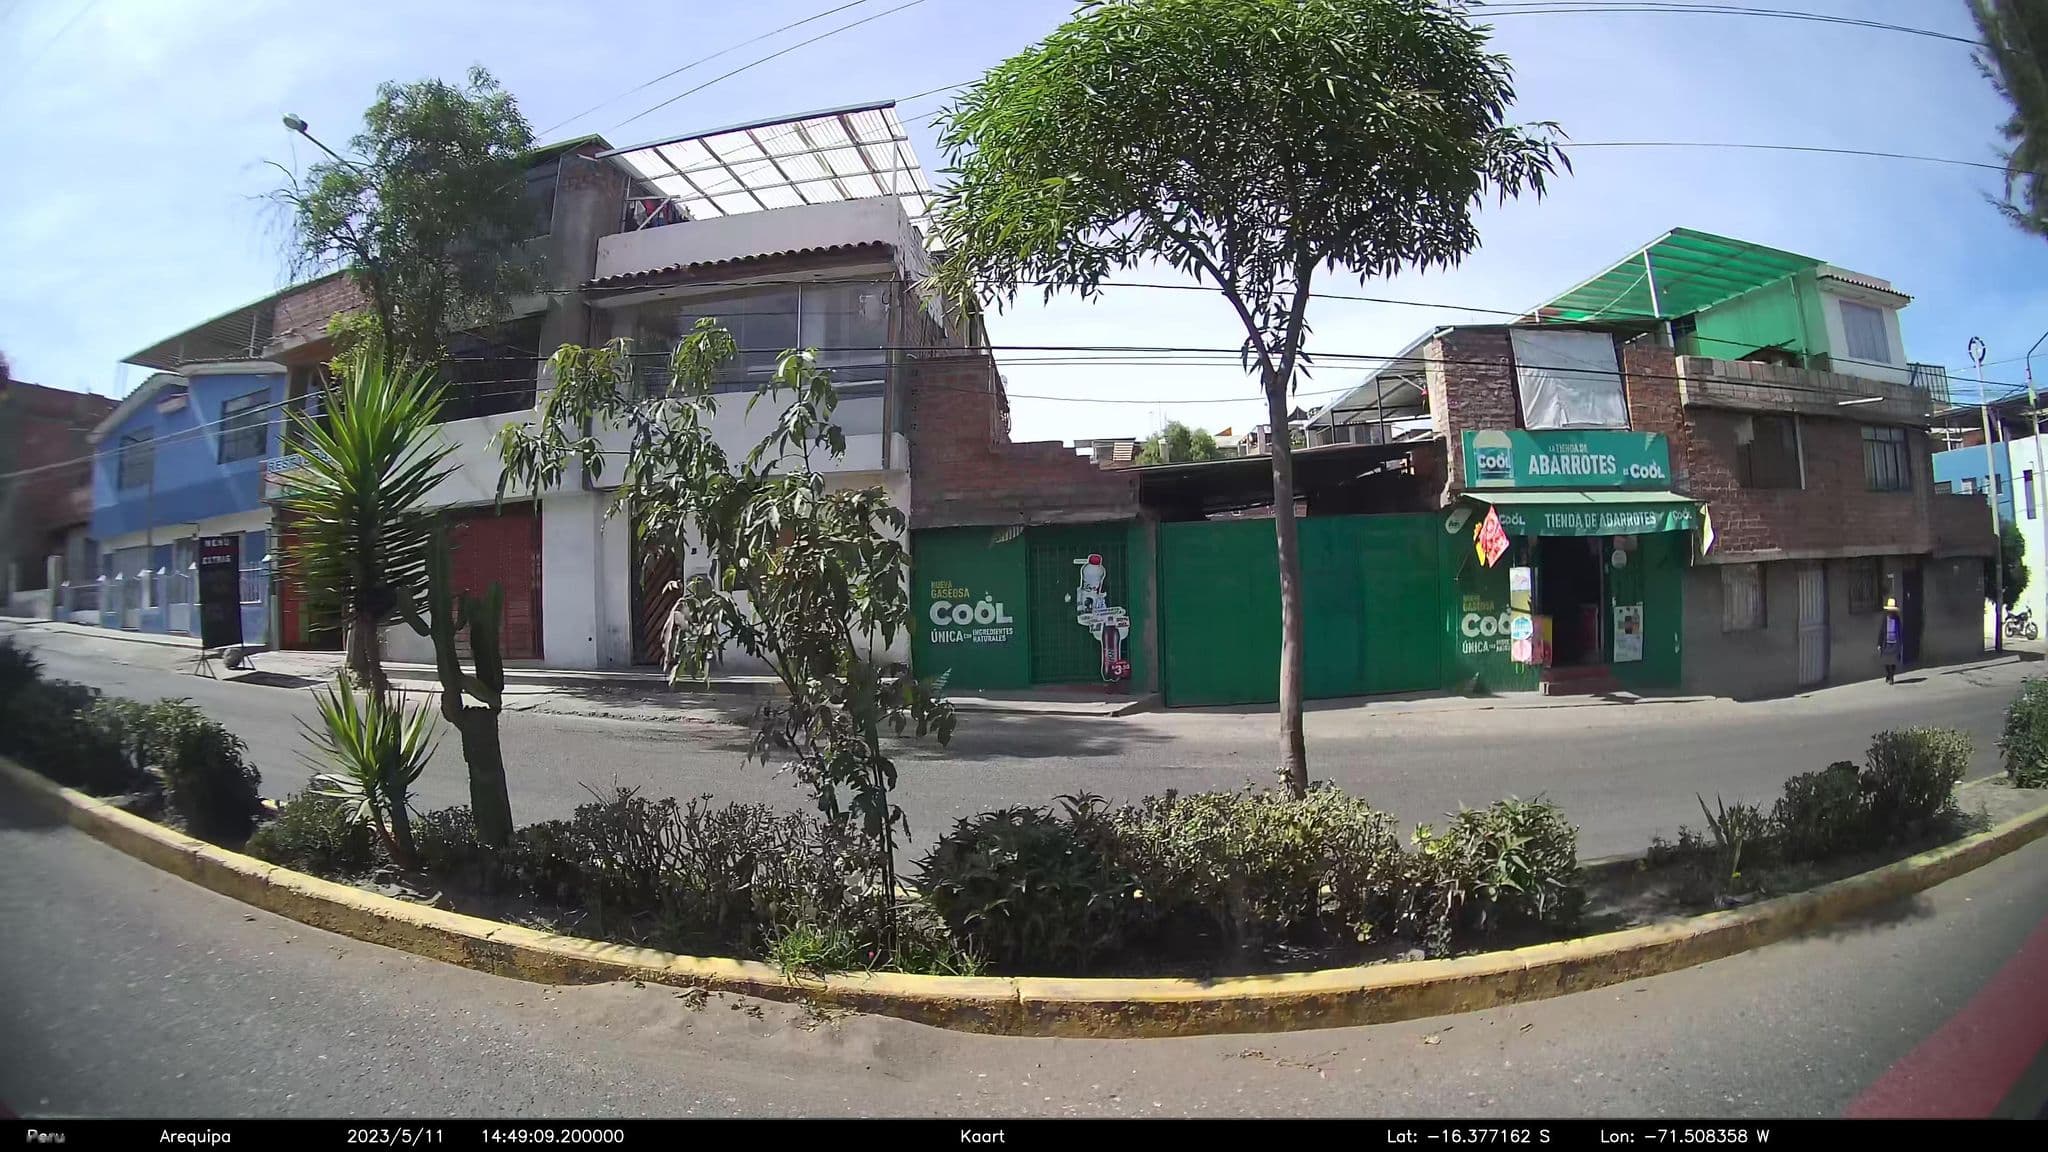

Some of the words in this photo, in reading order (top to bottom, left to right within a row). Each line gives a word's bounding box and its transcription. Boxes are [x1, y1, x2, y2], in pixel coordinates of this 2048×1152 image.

[1528, 454, 1617, 475] ABARROTES
[1544, 513, 1583, 528] TIENDA
[1585, 513, 1597, 528] DE
[1600, 511, 1657, 528] ABARROTES
[931, 588, 970, 599] GASEOSA
[1461, 607, 1512, 638] COO
[931, 629, 964, 643] ÚNICA
